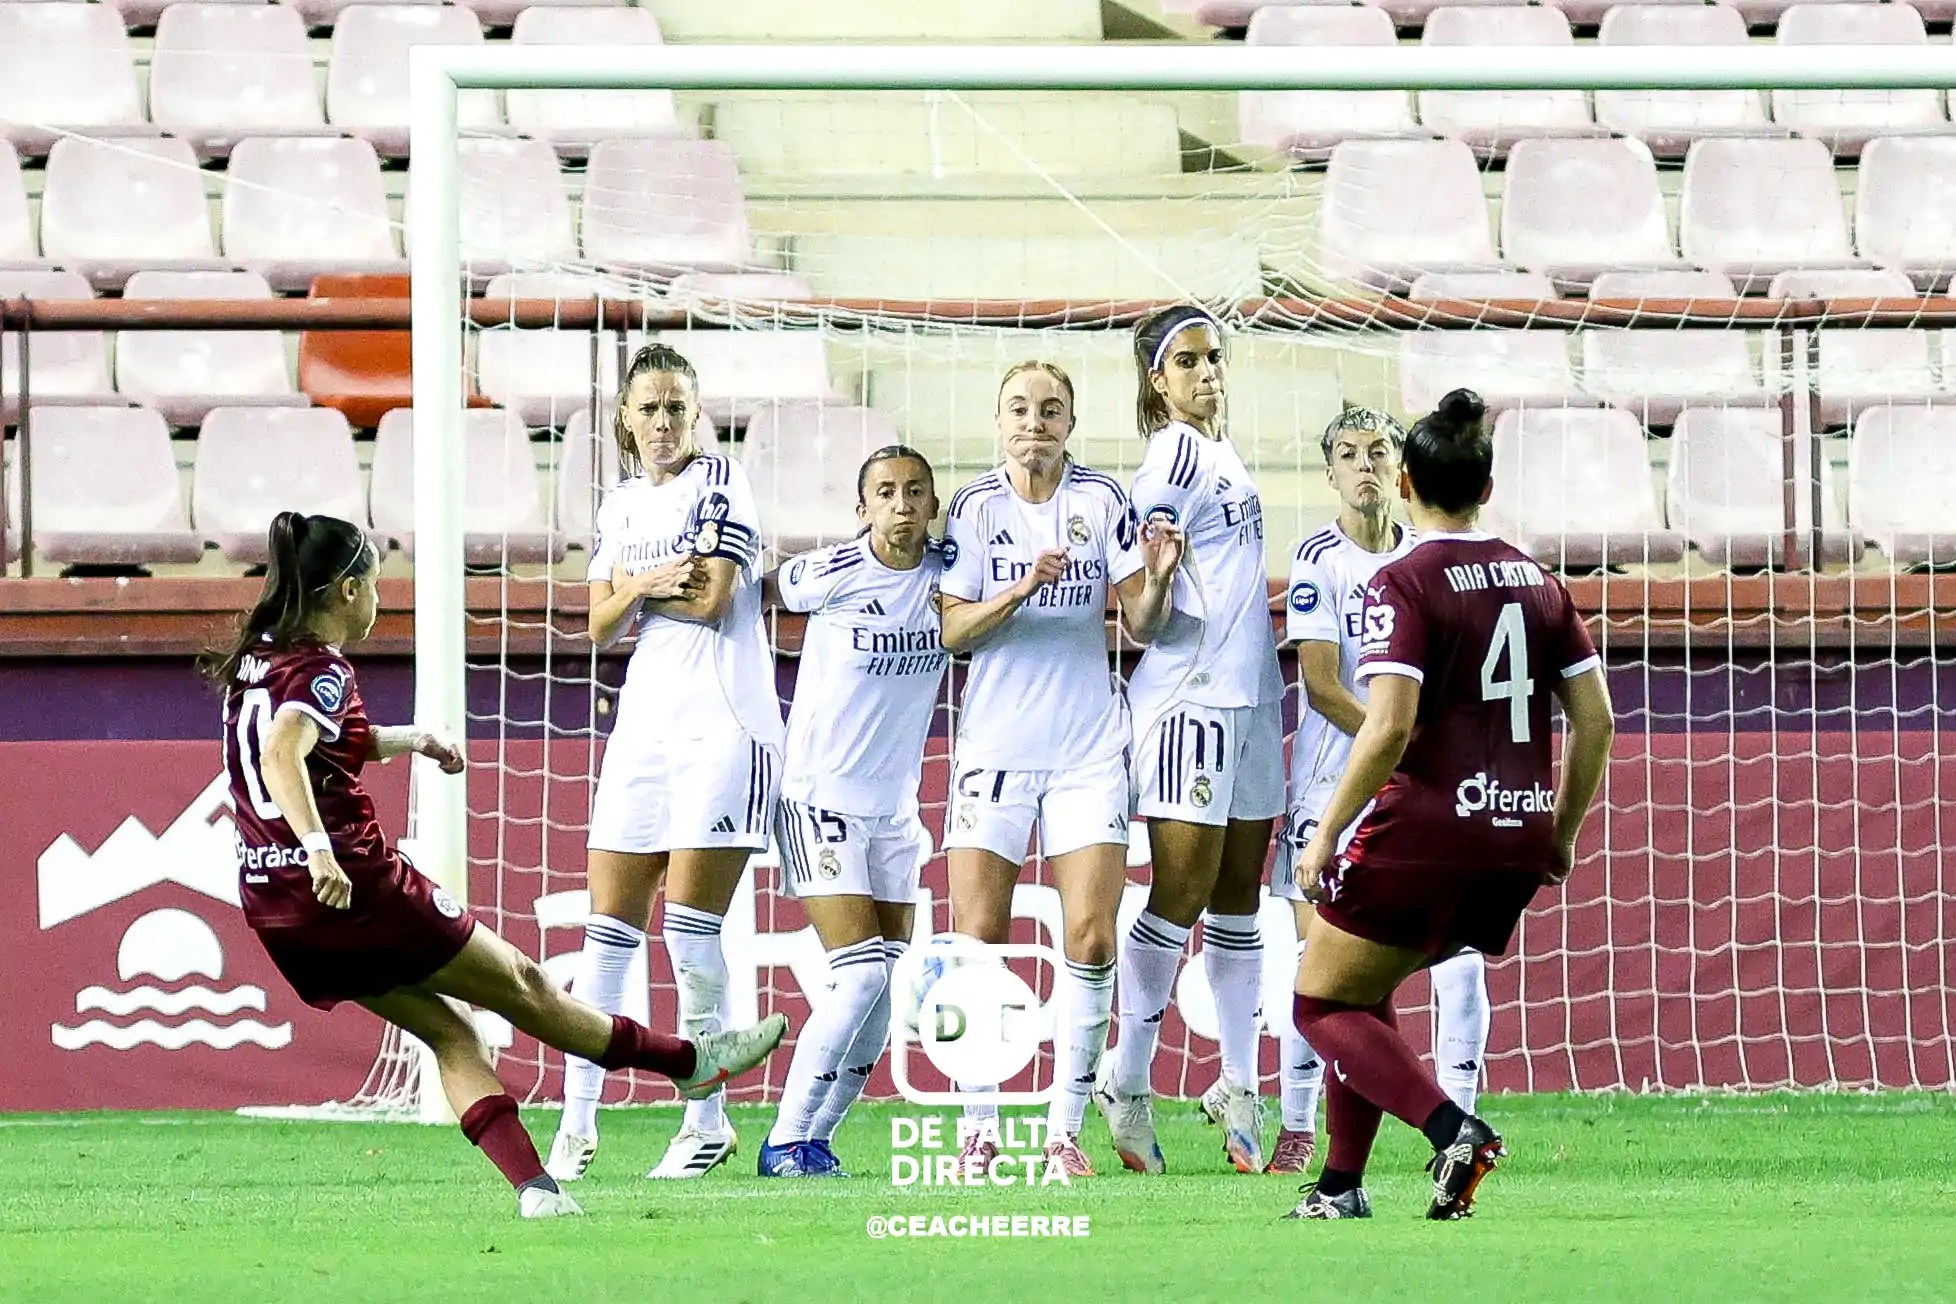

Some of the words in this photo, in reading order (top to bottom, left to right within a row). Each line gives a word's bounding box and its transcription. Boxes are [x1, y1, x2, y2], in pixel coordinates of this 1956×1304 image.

[1443, 563, 1489, 592] IRIA
[1038, 584, 1093, 607] BETTER
[867, 656, 895, 675] FLY
[895, 652, 945, 675] BETTER
[1481, 602, 1535, 743] 4
